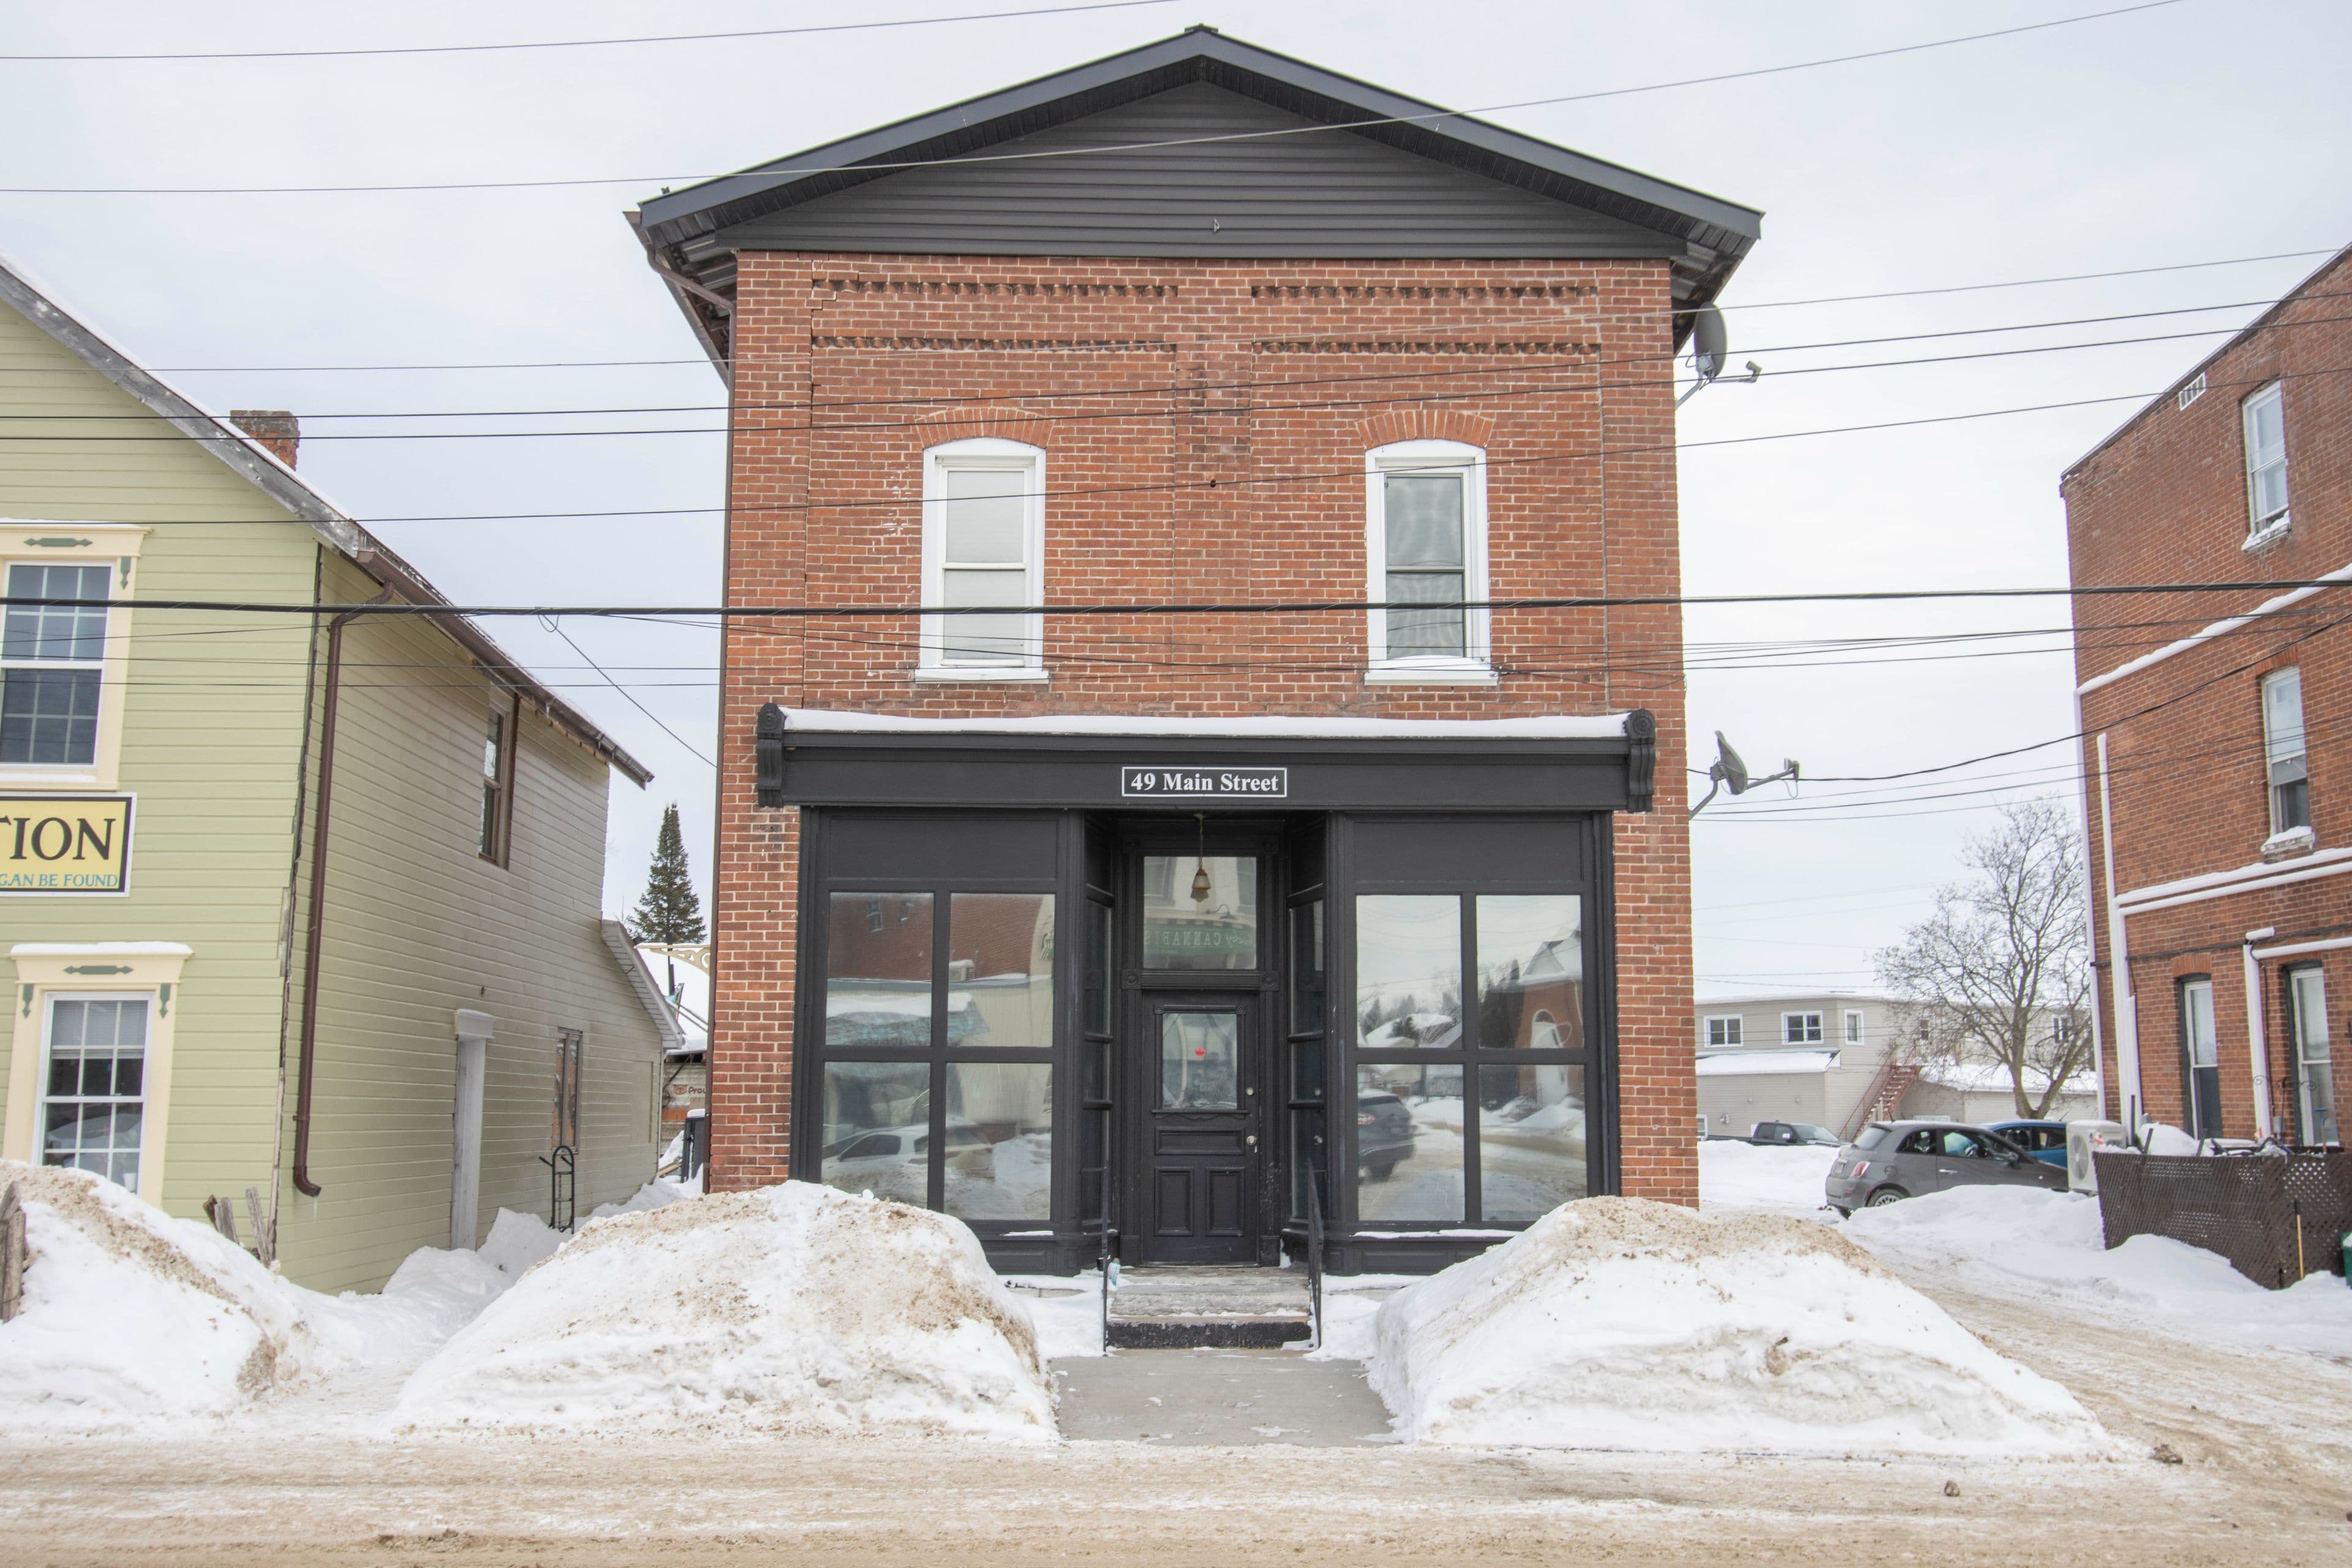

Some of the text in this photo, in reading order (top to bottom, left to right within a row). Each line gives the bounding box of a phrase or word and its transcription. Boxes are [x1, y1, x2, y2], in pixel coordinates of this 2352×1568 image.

[1131, 772, 1278, 791] 49 Main Street
[38, 874, 58, 887] BE
[64, 874, 118, 888] FOUND
